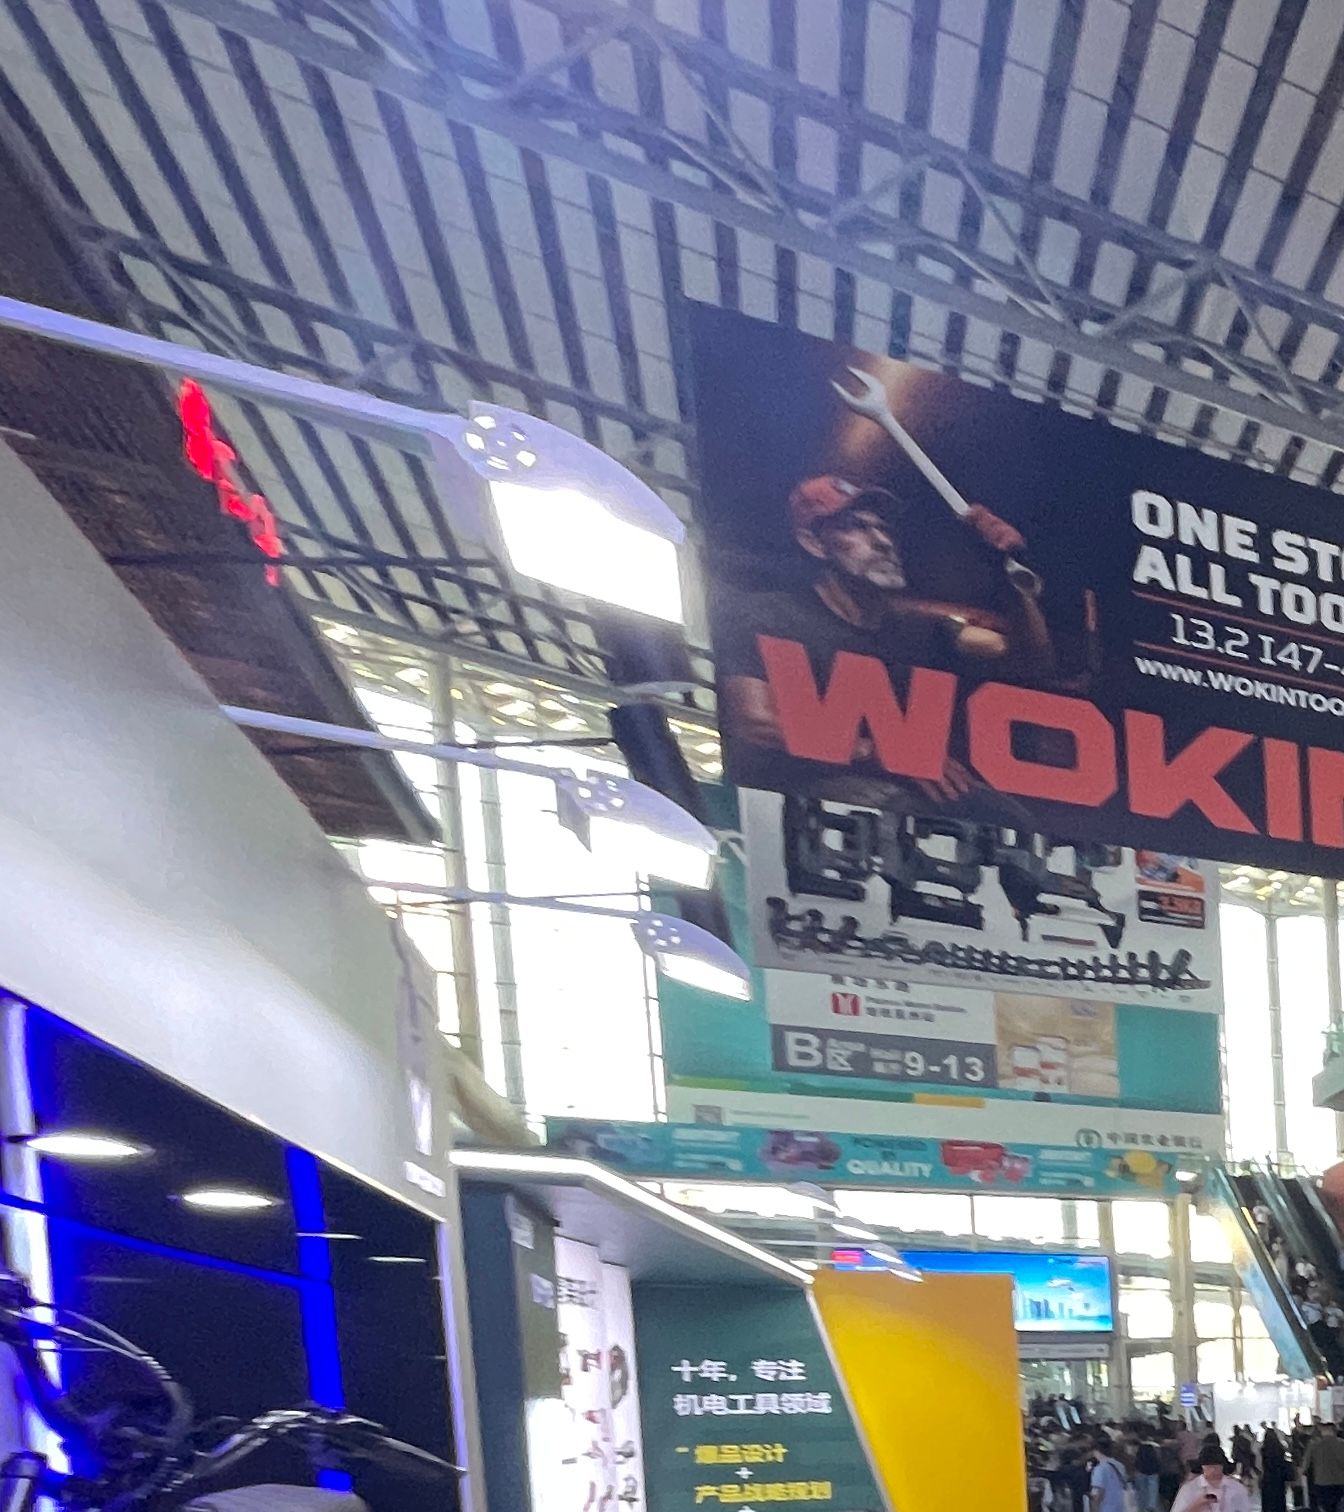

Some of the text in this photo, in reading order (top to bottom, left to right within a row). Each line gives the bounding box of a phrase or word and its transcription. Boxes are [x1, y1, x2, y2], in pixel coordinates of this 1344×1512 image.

[1131, 489, 1260, 563] ONE
[1132, 545, 1242, 607] ALL
[1170, 613, 1249, 659] 13.2
[904, 1051, 985, 1082] 9-13
[846, 1160, 933, 1178] QUALITY
[672, 1392, 833, 1416] 机电工具领域
